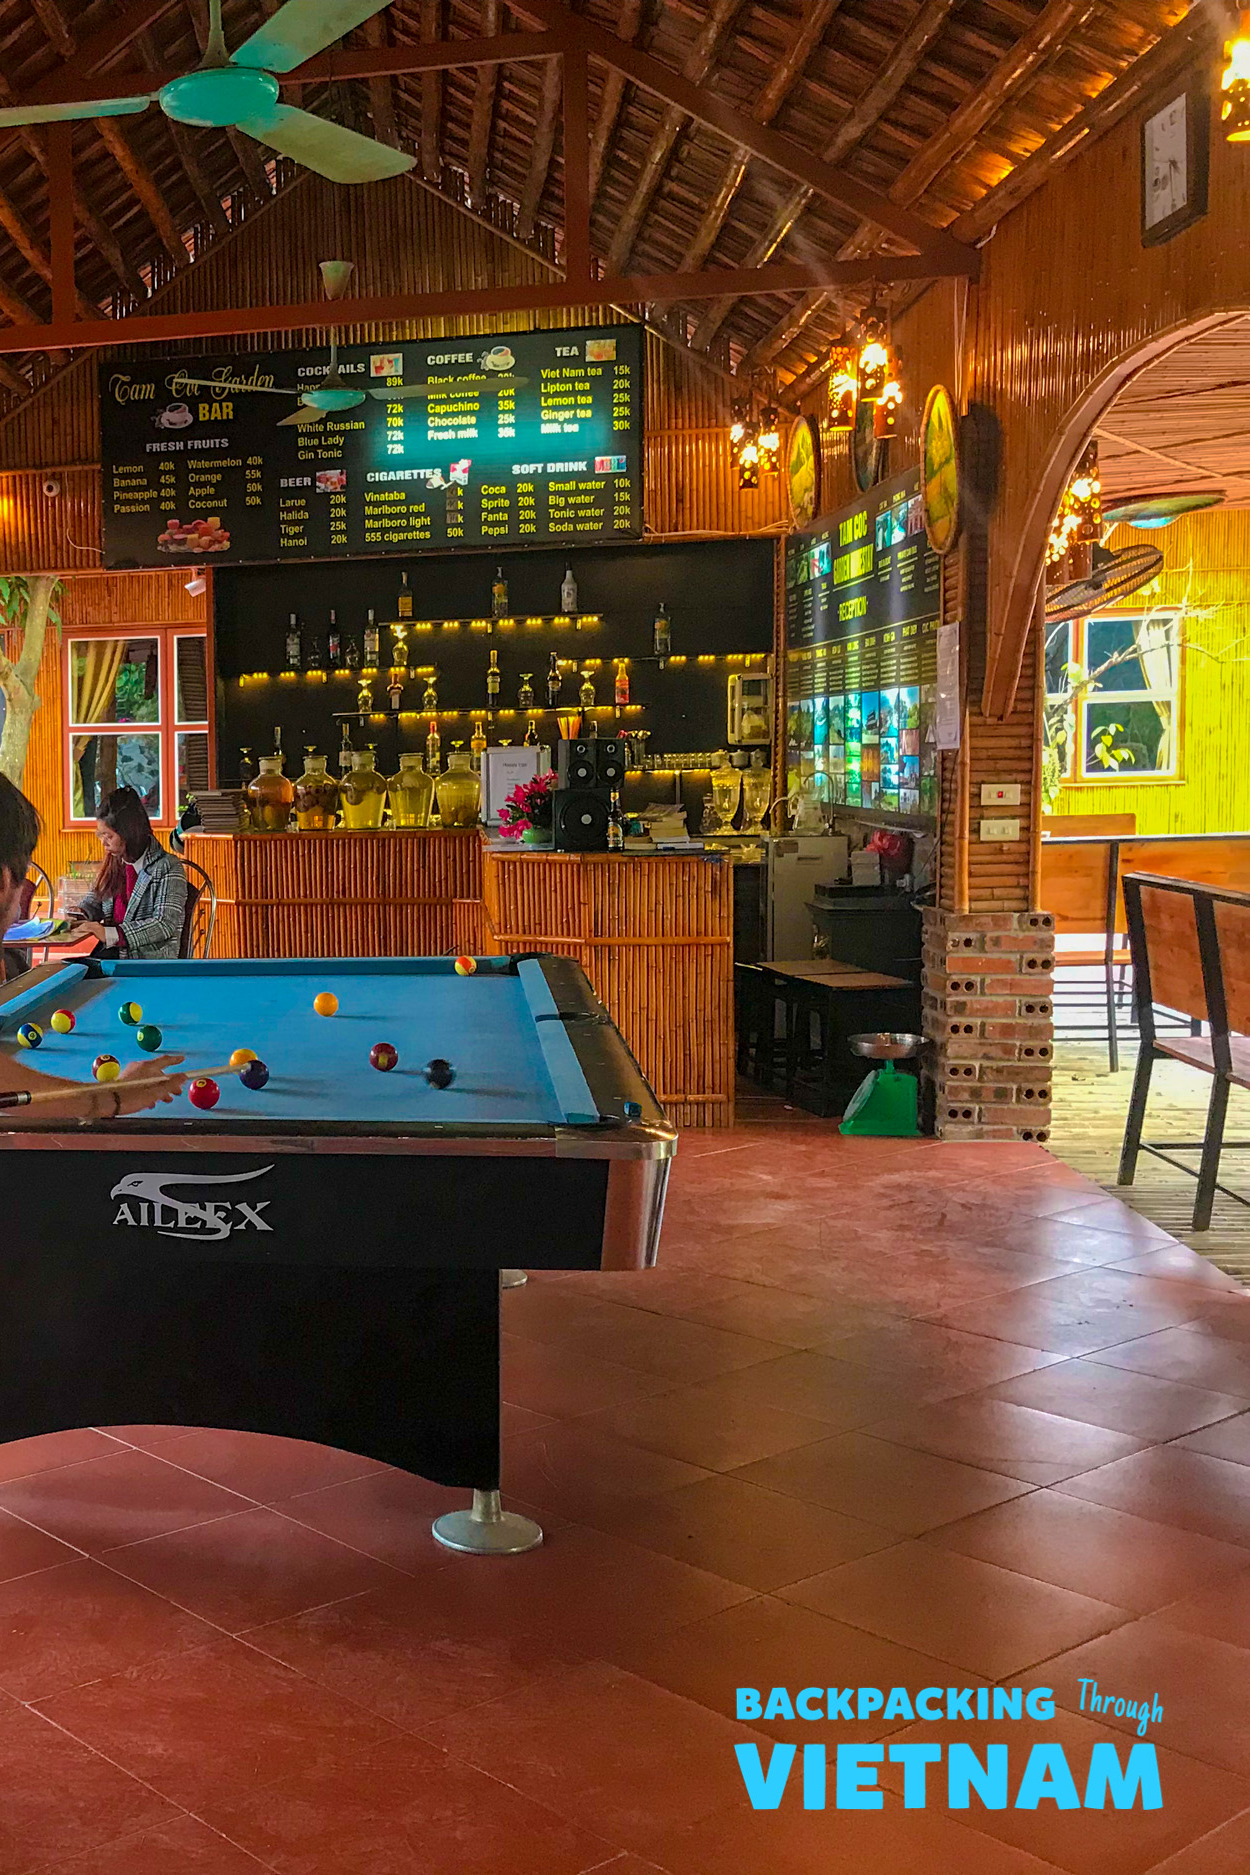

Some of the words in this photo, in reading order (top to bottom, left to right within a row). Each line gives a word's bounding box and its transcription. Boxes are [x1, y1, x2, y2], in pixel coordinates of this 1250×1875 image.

[555, 347, 579, 357] TEA
[427, 353, 473, 366] COFFEE
[297, 363, 366, 378] COCKAILS
[541, 369, 560, 379] Viet
[562, 368, 584, 378] Nam
[588, 367, 602, 376] tea
[614, 365, 630, 375] 15k
[386, 376, 403, 386] 89k
[541, 383, 572, 393] Lipton
[575, 382, 590, 391] tea
[613, 380, 630, 389] 20k
[109, 374, 155, 405] Tam
[541, 396, 572, 406] Lemon
[577, 396, 592, 404] tea
[613, 393, 630, 402] 25k
[198, 402, 234, 421] BAR
[387, 404, 404, 414] 72k
[427, 402, 480, 414] Capuchino
[498, 401, 515, 410] 35k
[541, 410, 575, 422] Ginger
[576, 409, 592, 418] tea
[613, 407, 630, 416] 25k
[297, 424, 324, 433] White
[326, 420, 366, 431] Russian
[387, 417, 404, 426] 70k
[427, 415, 476, 427] Chocolate
[498, 414, 515, 424] 25k
[613, 420, 630, 430] 30k
[146, 441, 184, 452] FRESH
[188, 438, 229, 450] FRUITS
[297, 437, 319, 446] Blue
[322, 435, 345, 446] Lady
[387, 430, 404, 440] 72k
[298, 450, 314, 460] Gin
[317, 449, 342, 458] Tonic
[387, 444, 404, 454] 72k
[113, 464, 144, 474] Lemon
[158, 462, 175, 471] 40k
[187, 458, 242, 470] Watermelon
[246, 456, 263, 466] 40k
[512, 464, 544, 474] SOFT
[546, 462, 588, 472] DRINK
[113, 477, 148, 487] Banana
[160, 475, 176, 484] 45k
[188, 472, 222, 484] Orange
[246, 470, 262, 479] 55k
[366, 468, 442, 482] CIGARETTES
[280, 478, 312, 488] BEER
[481, 485, 506, 495] Coca
[517, 483, 534, 493] 20k
[548, 481, 576, 492] Small
[578, 480, 606, 490] water
[614, 478, 631, 488] 10k
[113, 490, 158, 500] Pineapple
[160, 488, 176, 498] 40k
[188, 486, 215, 497] Apple
[246, 483, 262, 492] 50k
[364, 492, 406, 502] Vinataba
[114, 504, 150, 514] Passion
[160, 501, 176, 510] 40k
[188, 498, 228, 509] Coconut
[246, 496, 262, 506] 50k
[280, 498, 306, 508] Larue
[330, 495, 346, 504] 20k
[481, 498, 510, 510] Sprite
[518, 497, 535, 506] 20k
[548, 495, 565, 506] Big
[567, 494, 595, 504] water
[614, 492, 631, 502] 15k
[280, 510, 309, 521] Halida
[330, 508, 346, 518] 20k
[364, 504, 407, 516] Marlboro
[409, 503, 426, 513] red
[481, 512, 508, 522] Fanta
[519, 510, 536, 520] 20k
[548, 508, 576, 518] Tonic
[577, 508, 604, 517] water
[614, 506, 631, 516] 20k
[280, 524, 304, 536] Tiger
[330, 522, 346, 532] 25k
[365, 518, 407, 529] Marlboro
[410, 516, 431, 528] light
[482, 525, 508, 536] Pepsi
[519, 524, 536, 534] 20k
[548, 522, 574, 532] Soda
[576, 521, 604, 531] water
[614, 520, 631, 529] 20k
[280, 537, 308, 547] Hanoi
[330, 535, 348, 544] 20k
[365, 532, 382, 542] 555
[384, 530, 431, 541] cigarettes
[447, 528, 464, 538] 50k
[838, 596, 867, 622] RECEPTION
